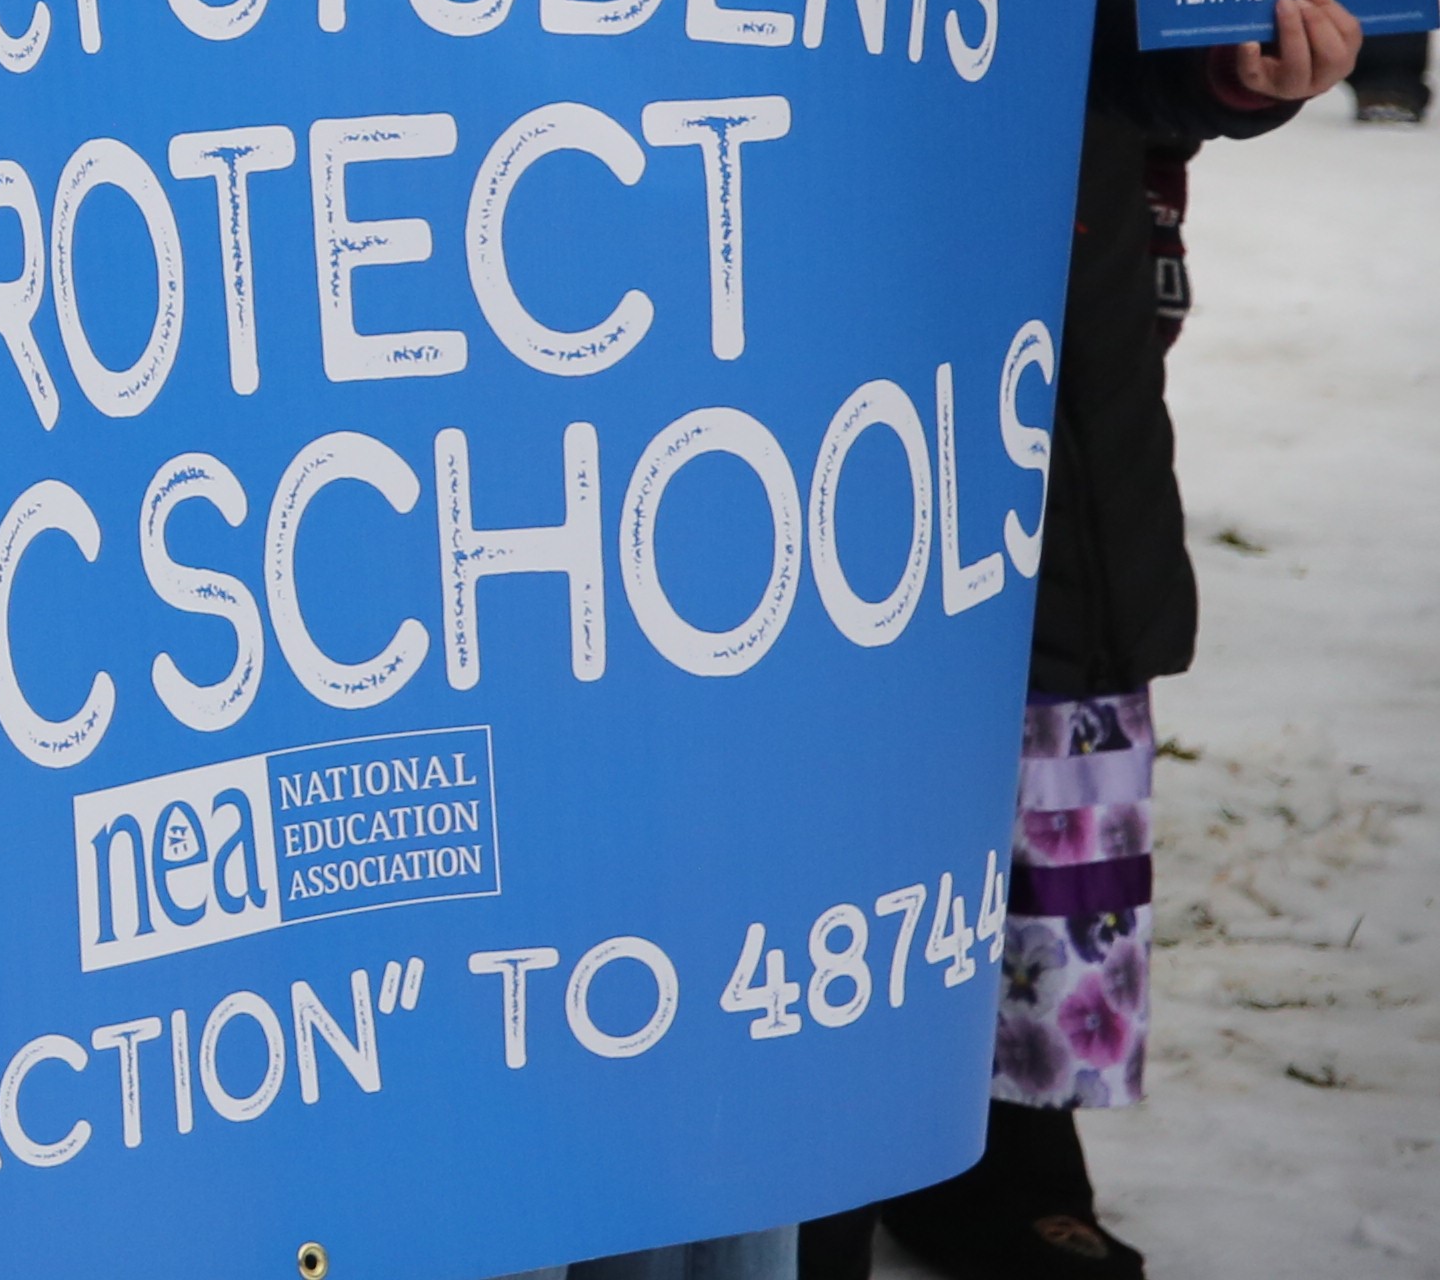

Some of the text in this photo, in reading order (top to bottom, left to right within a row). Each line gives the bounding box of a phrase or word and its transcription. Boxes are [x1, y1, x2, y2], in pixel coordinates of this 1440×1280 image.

[141, 318, 1057, 735] SCHOOLS
[93, 750, 478, 946] nea NATIONAL
[282, 801, 482, 856] EDUCATION
[288, 845, 484, 902] ASSOCIATION
[468, 933, 681, 1071] TO
[718, 847, 1009, 1044] 48744
